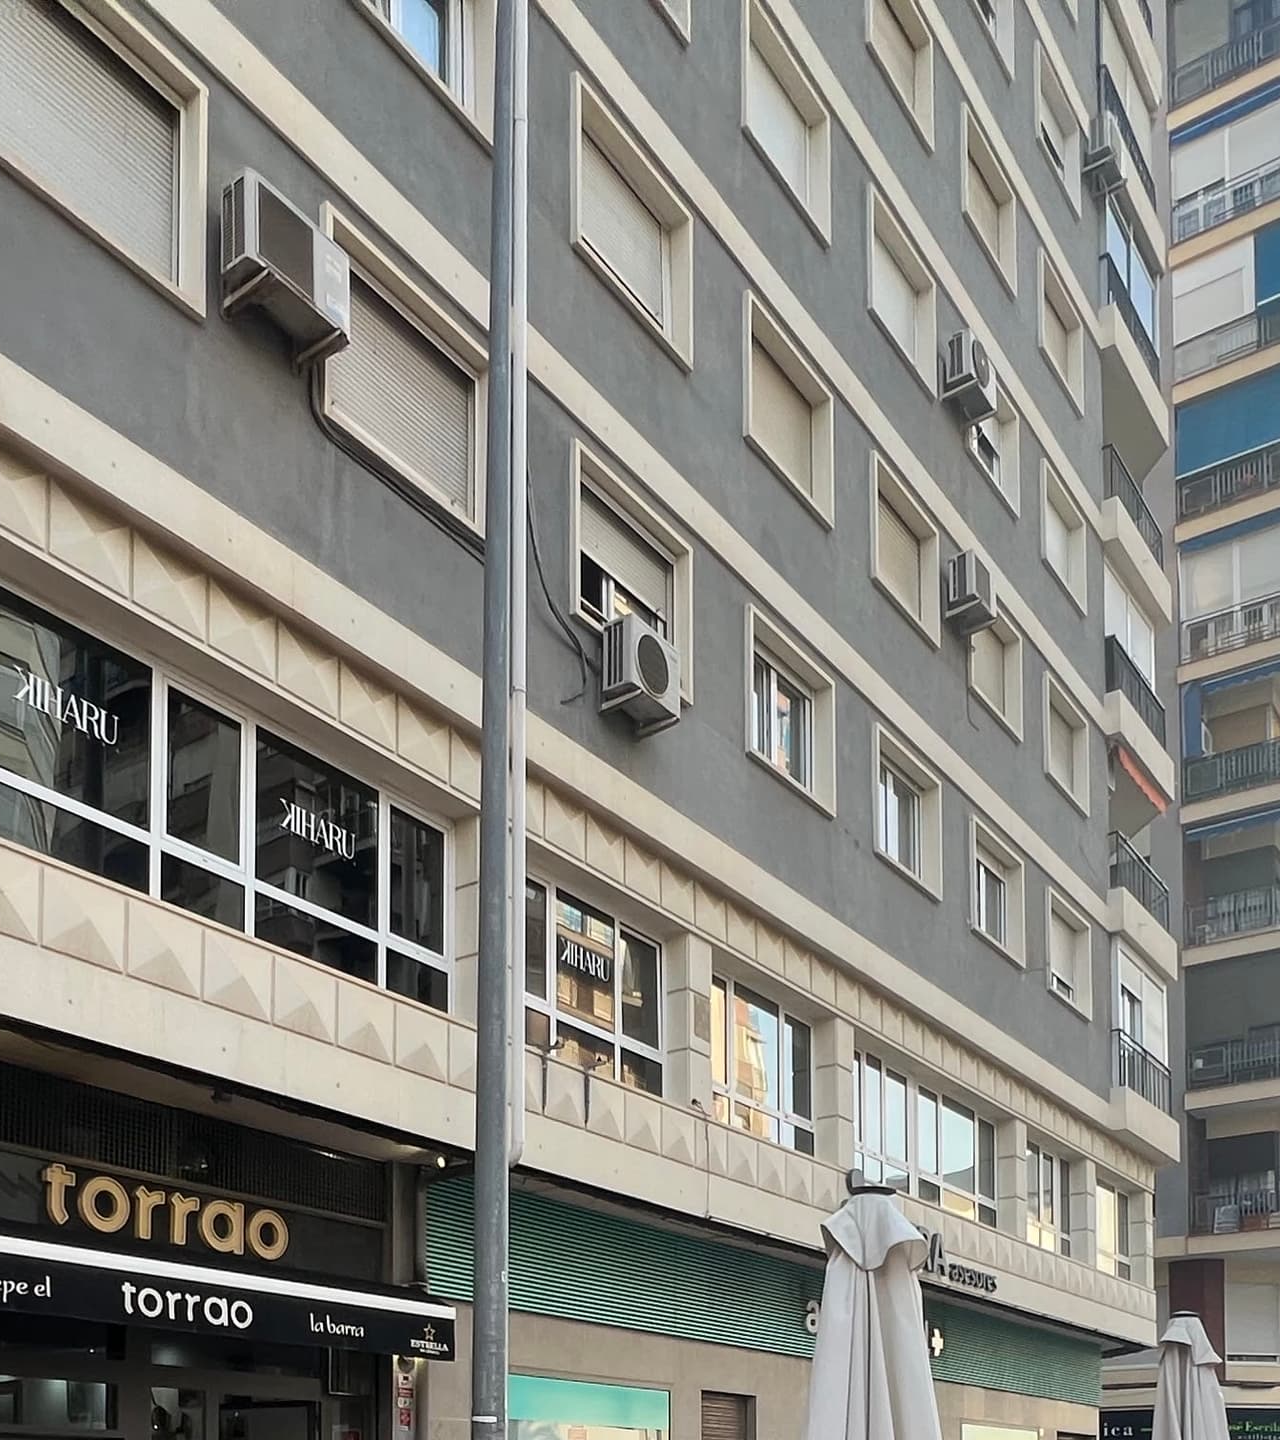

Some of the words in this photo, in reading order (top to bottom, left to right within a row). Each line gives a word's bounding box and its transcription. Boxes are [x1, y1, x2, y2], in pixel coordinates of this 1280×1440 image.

[42, 1163, 289, 1261] torrao
[33, 1275, 52, 1297] el
[121, 1281, 253, 1329] torrao
[309, 1312, 324, 1332] la
[326, 1314, 365, 1338] barra
[1103, 1422, 1134, 1437] ica
